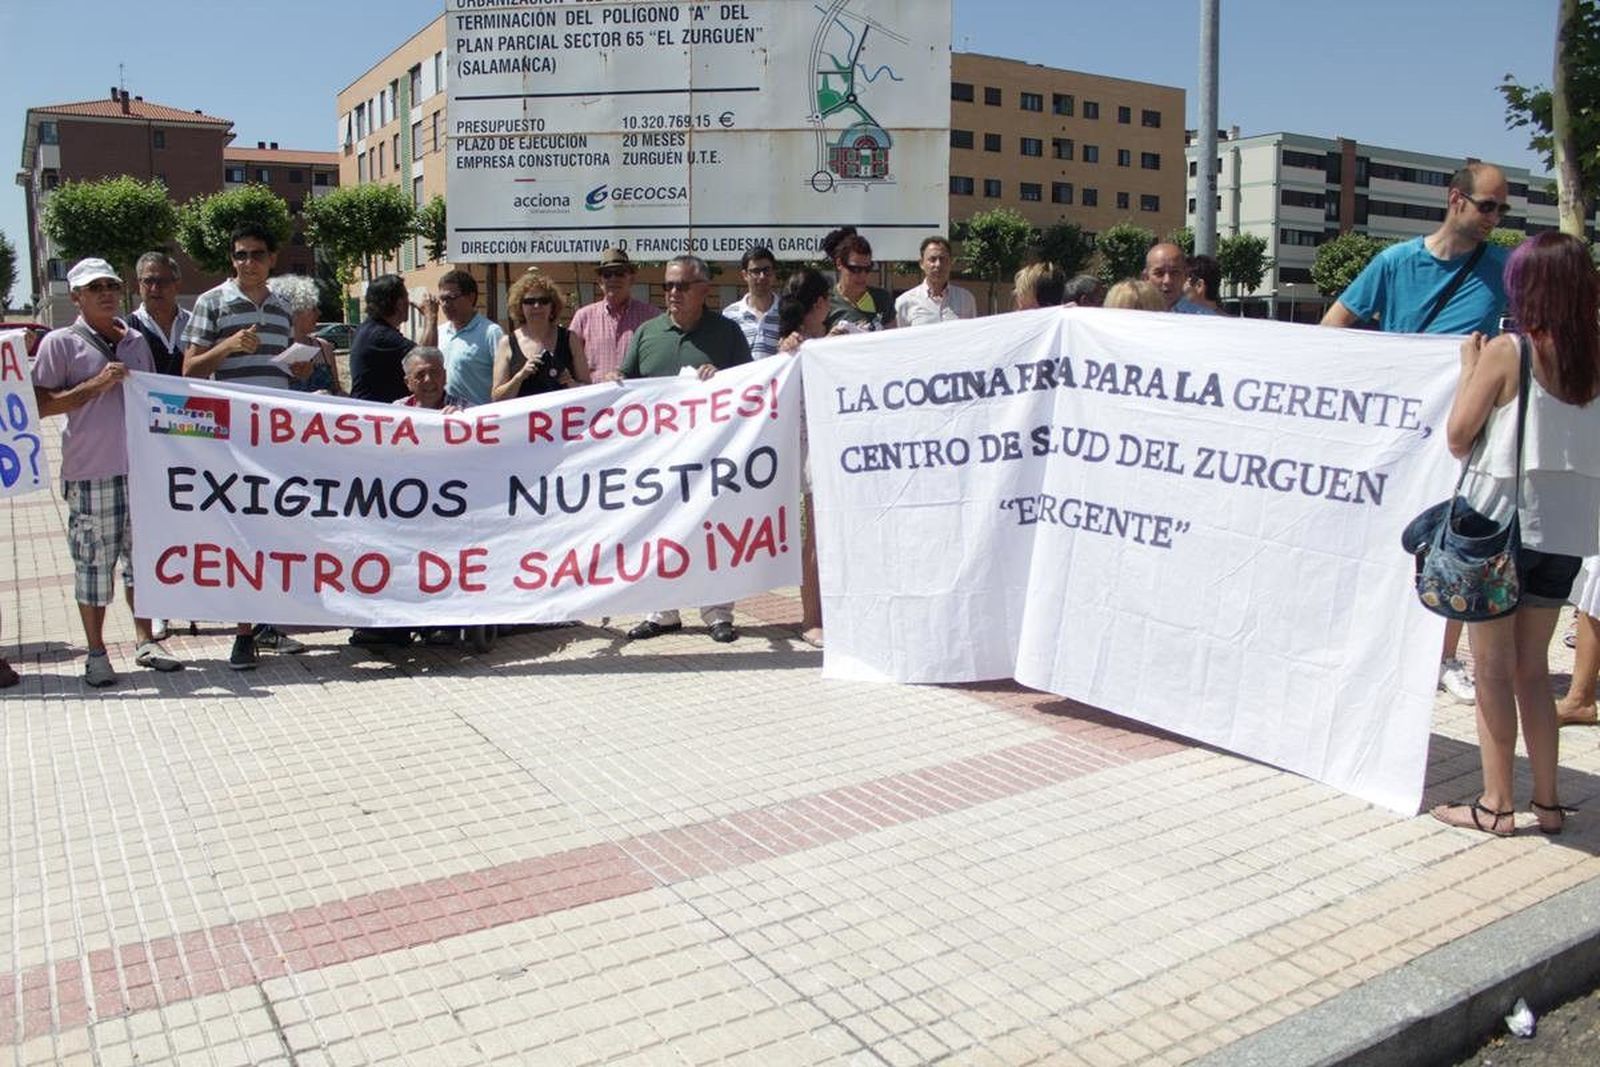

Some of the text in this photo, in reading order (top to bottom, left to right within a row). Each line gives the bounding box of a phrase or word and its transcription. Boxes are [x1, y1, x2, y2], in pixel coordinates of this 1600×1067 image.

[566, 10, 593, 25] DEL
[721, 4, 749, 20] DEL
[457, 37, 493, 53] PLAN
[498, 35, 559, 51] PARCIAL
[564, 32, 622, 49] SECTOR
[626, 31, 644, 46] 65
[457, 56, 557, 76] (SALAMANCA)
[457, 118, 545, 134] PRESUPUESTO
[718, 111, 736, 128] €
[457, 137, 496, 151] PLAZO
[499, 137, 516, 150] DE
[622, 134, 638, 147] 20
[642, 132, 685, 146] MESES
[457, 154, 514, 169] EMPRESA
[519, 152, 610, 167] CONSTUCTORA
[687, 151, 722, 164] U.T.E.
[513, 193, 570, 208] acciona
[611, 187, 687, 200] GECOCSA
[461, 238, 527, 254] DIRECCIÓN
[636, 238, 708, 252] FRANCISCO
[713, 238, 773, 250] LEDESMA
[836, 384, 878, 414] LA
[883, 368, 1013, 410] COCINA
[1082, 359, 1169, 401] PARA
[1173, 371, 1225, 408] LA
[1233, 378, 1433, 439] GERENTE,
[251, 378, 779, 447] ¡BASTA DE RECORTES!
[841, 437, 970, 474] CENTRO
[979, 431, 1024, 463] DE
[1116, 434, 1185, 475] DEL
[1193, 447, 1389, 505] ZURGUEN
[167, 446, 778, 519] EXIGIMOS NUESTRO
[155, 543, 391, 594] CENTRO
[418, 547, 488, 593] DE
[513, 538, 690, 590] SALUD
